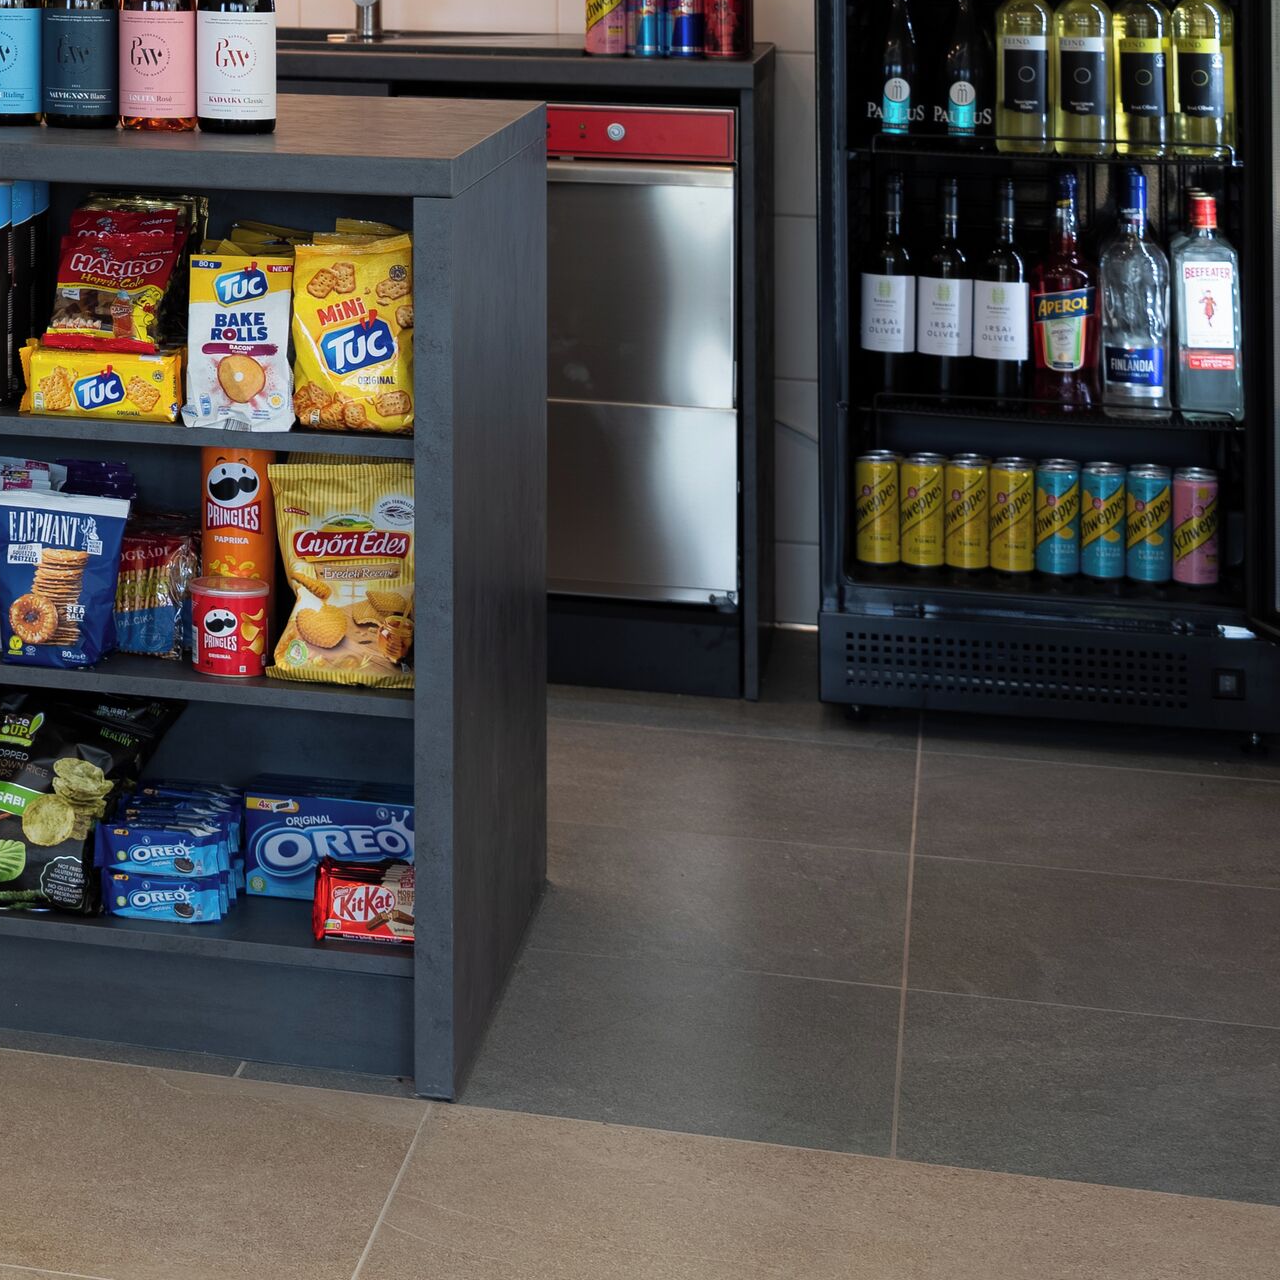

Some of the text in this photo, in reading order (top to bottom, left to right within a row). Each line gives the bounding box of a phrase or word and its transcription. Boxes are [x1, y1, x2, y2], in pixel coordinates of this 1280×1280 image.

[867, 101, 925, 122] PAULUS
[71, 254, 164, 277] HARIBO
[198, 260, 208, 268] 80
[1184, 266, 1231, 279] BEEFEATER
[218, 276, 265, 300] TUC
[1038, 296, 1089, 317] APEROL
[215, 312, 266, 328] BAKE
[871, 317, 898, 325] IRSAI
[930, 321, 957, 329] IRSAI
[211, 325, 268, 342] ROLLS
[985, 324, 1012, 332] IRSAI
[327, 331, 389, 369] TUC
[1111, 358, 1154, 372] FINLANDIA
[358, 375, 395, 386] ORIGINAL
[78, 378, 120, 406] TUC
[207, 505, 259, 530] PRINGLES
[9, 511, 81, 547] ELEPHANT
[214, 535, 249, 545] PAPRIKA
[296, 529, 407, 558] Győri Édes
[9, 555, 38, 563] PRETZELS
[323, 567, 360, 580] Eredeti
[66, 612, 85, 620] SALT
[204, 635, 237, 651] PRINGLES
[258, 800, 271, 809] 4x
[285, 815, 333, 826] ORIGINAL
[133, 845, 185, 860] OREO
[263, 825, 407, 868] OREO
[133, 891, 185, 906] OREO
[339, 887, 393, 920] KitKat
